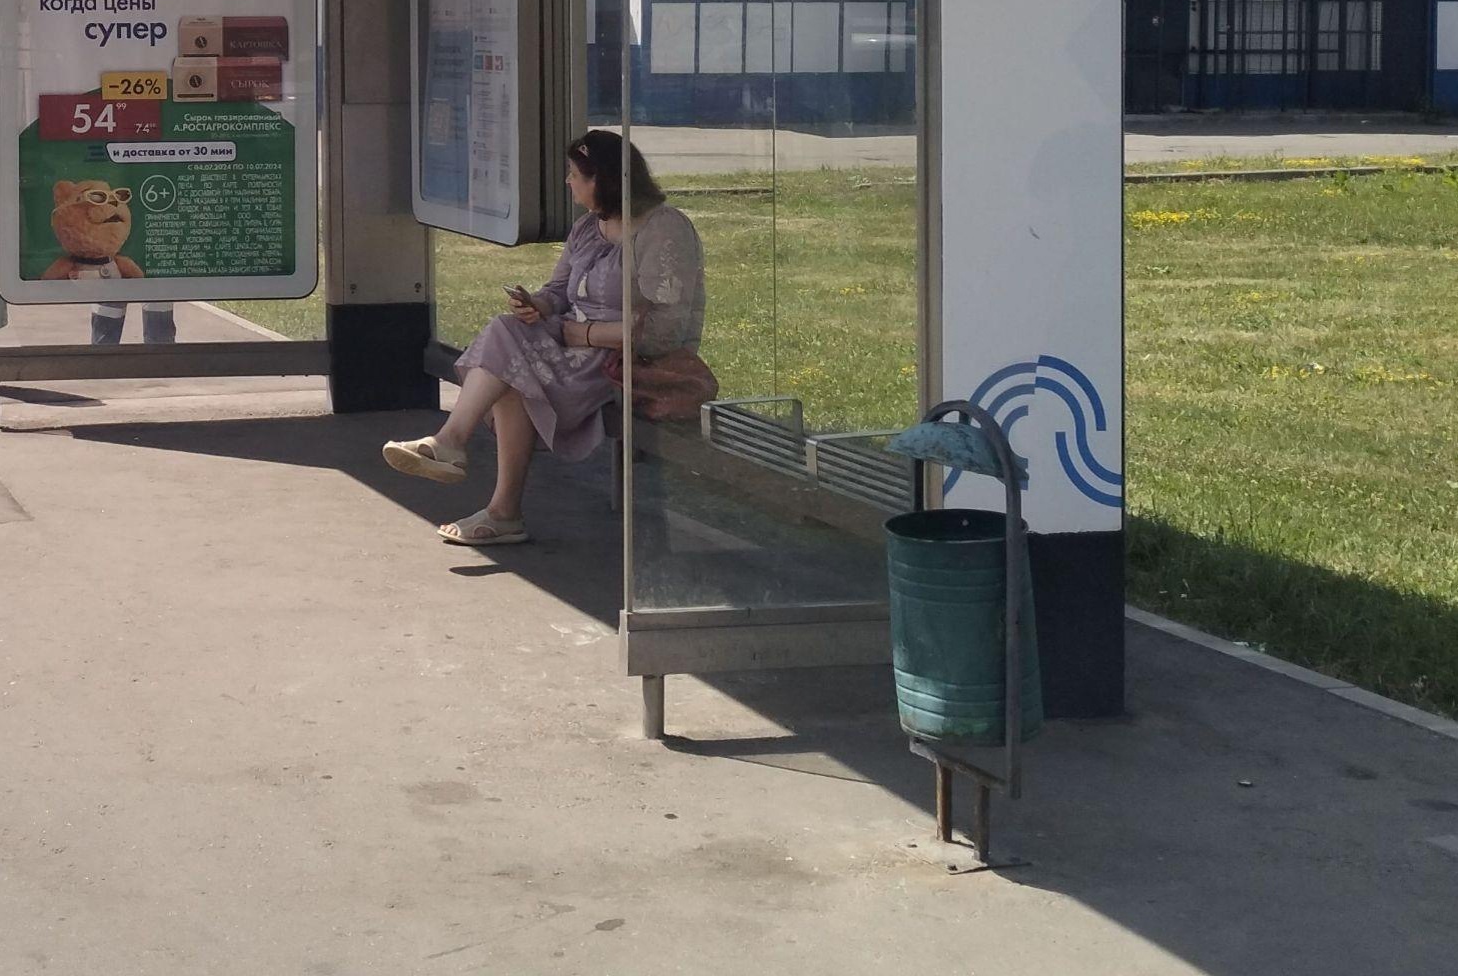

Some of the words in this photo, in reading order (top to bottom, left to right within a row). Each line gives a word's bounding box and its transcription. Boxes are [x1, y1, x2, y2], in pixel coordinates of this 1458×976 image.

[84, 21, 167, 46] супер
[108, 78, 161, 96] -26%
[230, 79, 270, 89] СЫРОК
[71, 104, 117, 134] 54
[183, 113, 212, 123] Сырок
[122, 147, 175, 158] доставка
[178, 148, 191, 156] от
[193, 146, 207, 156] 30
[210, 147, 233, 156] мин
[145, 185, 170, 203] 6+
